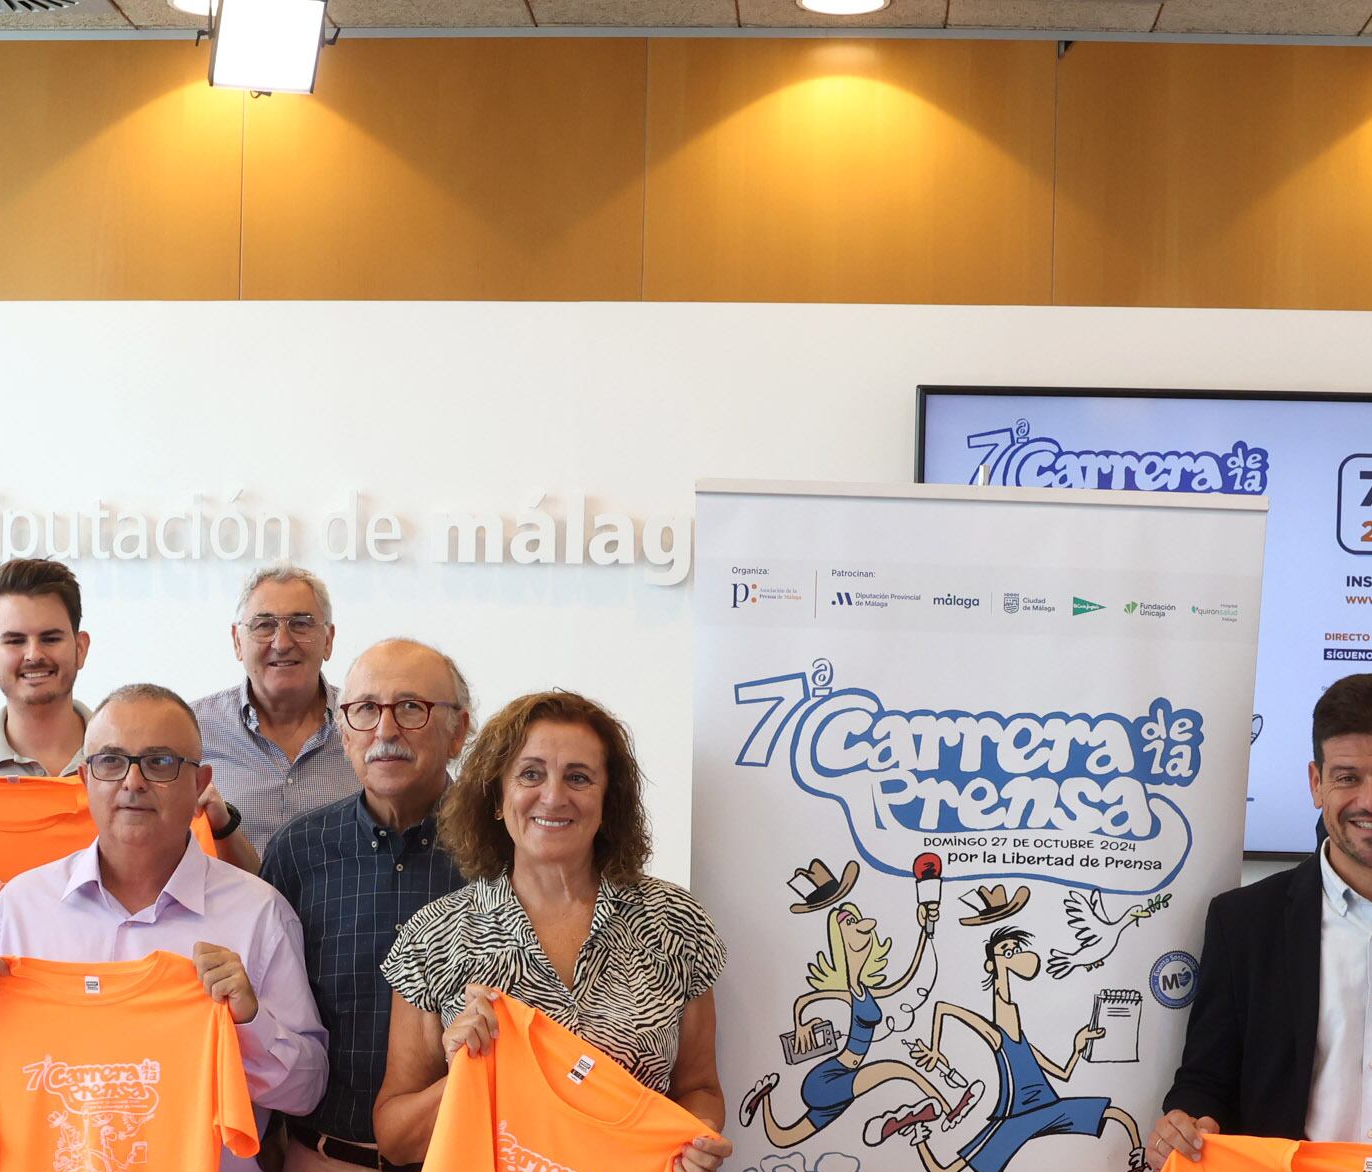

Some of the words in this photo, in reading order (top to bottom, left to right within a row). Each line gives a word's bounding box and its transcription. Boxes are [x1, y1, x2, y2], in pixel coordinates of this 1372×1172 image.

[1227, 447, 1260, 469] de
[325, 489, 403, 562] de
[432, 492, 693, 586] málag
[732, 567, 769, 576] Organiza:
[831, 570, 875, 578] Patrocinan:
[855, 592, 888, 601] Diputación
[891, 593, 921, 601] Provincial
[865, 600, 888, 608] Málaga
[933, 594, 979, 608] málaga
[1140, 603, 1176, 611] Fundación
[1140, 610, 1165, 618] Unicaja
[1325, 633, 1370, 642] DIRECTO
[1139, 707, 1191, 742] de
[816, 707, 1135, 773] Carrera
[1146, 743, 1194, 778] la
[872, 772, 1151, 840] Prensa
[992, 837, 1007, 848] 27
[1013, 838, 1031, 849] DE
[1034, 838, 1095, 850] OCTUBRE
[1100, 840, 1136, 853] 2024
[947, 852, 977, 868] por
[982, 851, 998, 865] la
[1002, 852, 1075, 868] Libertad
[1081, 853, 1100, 869] de
[1106, 855, 1163, 871] Prensa
